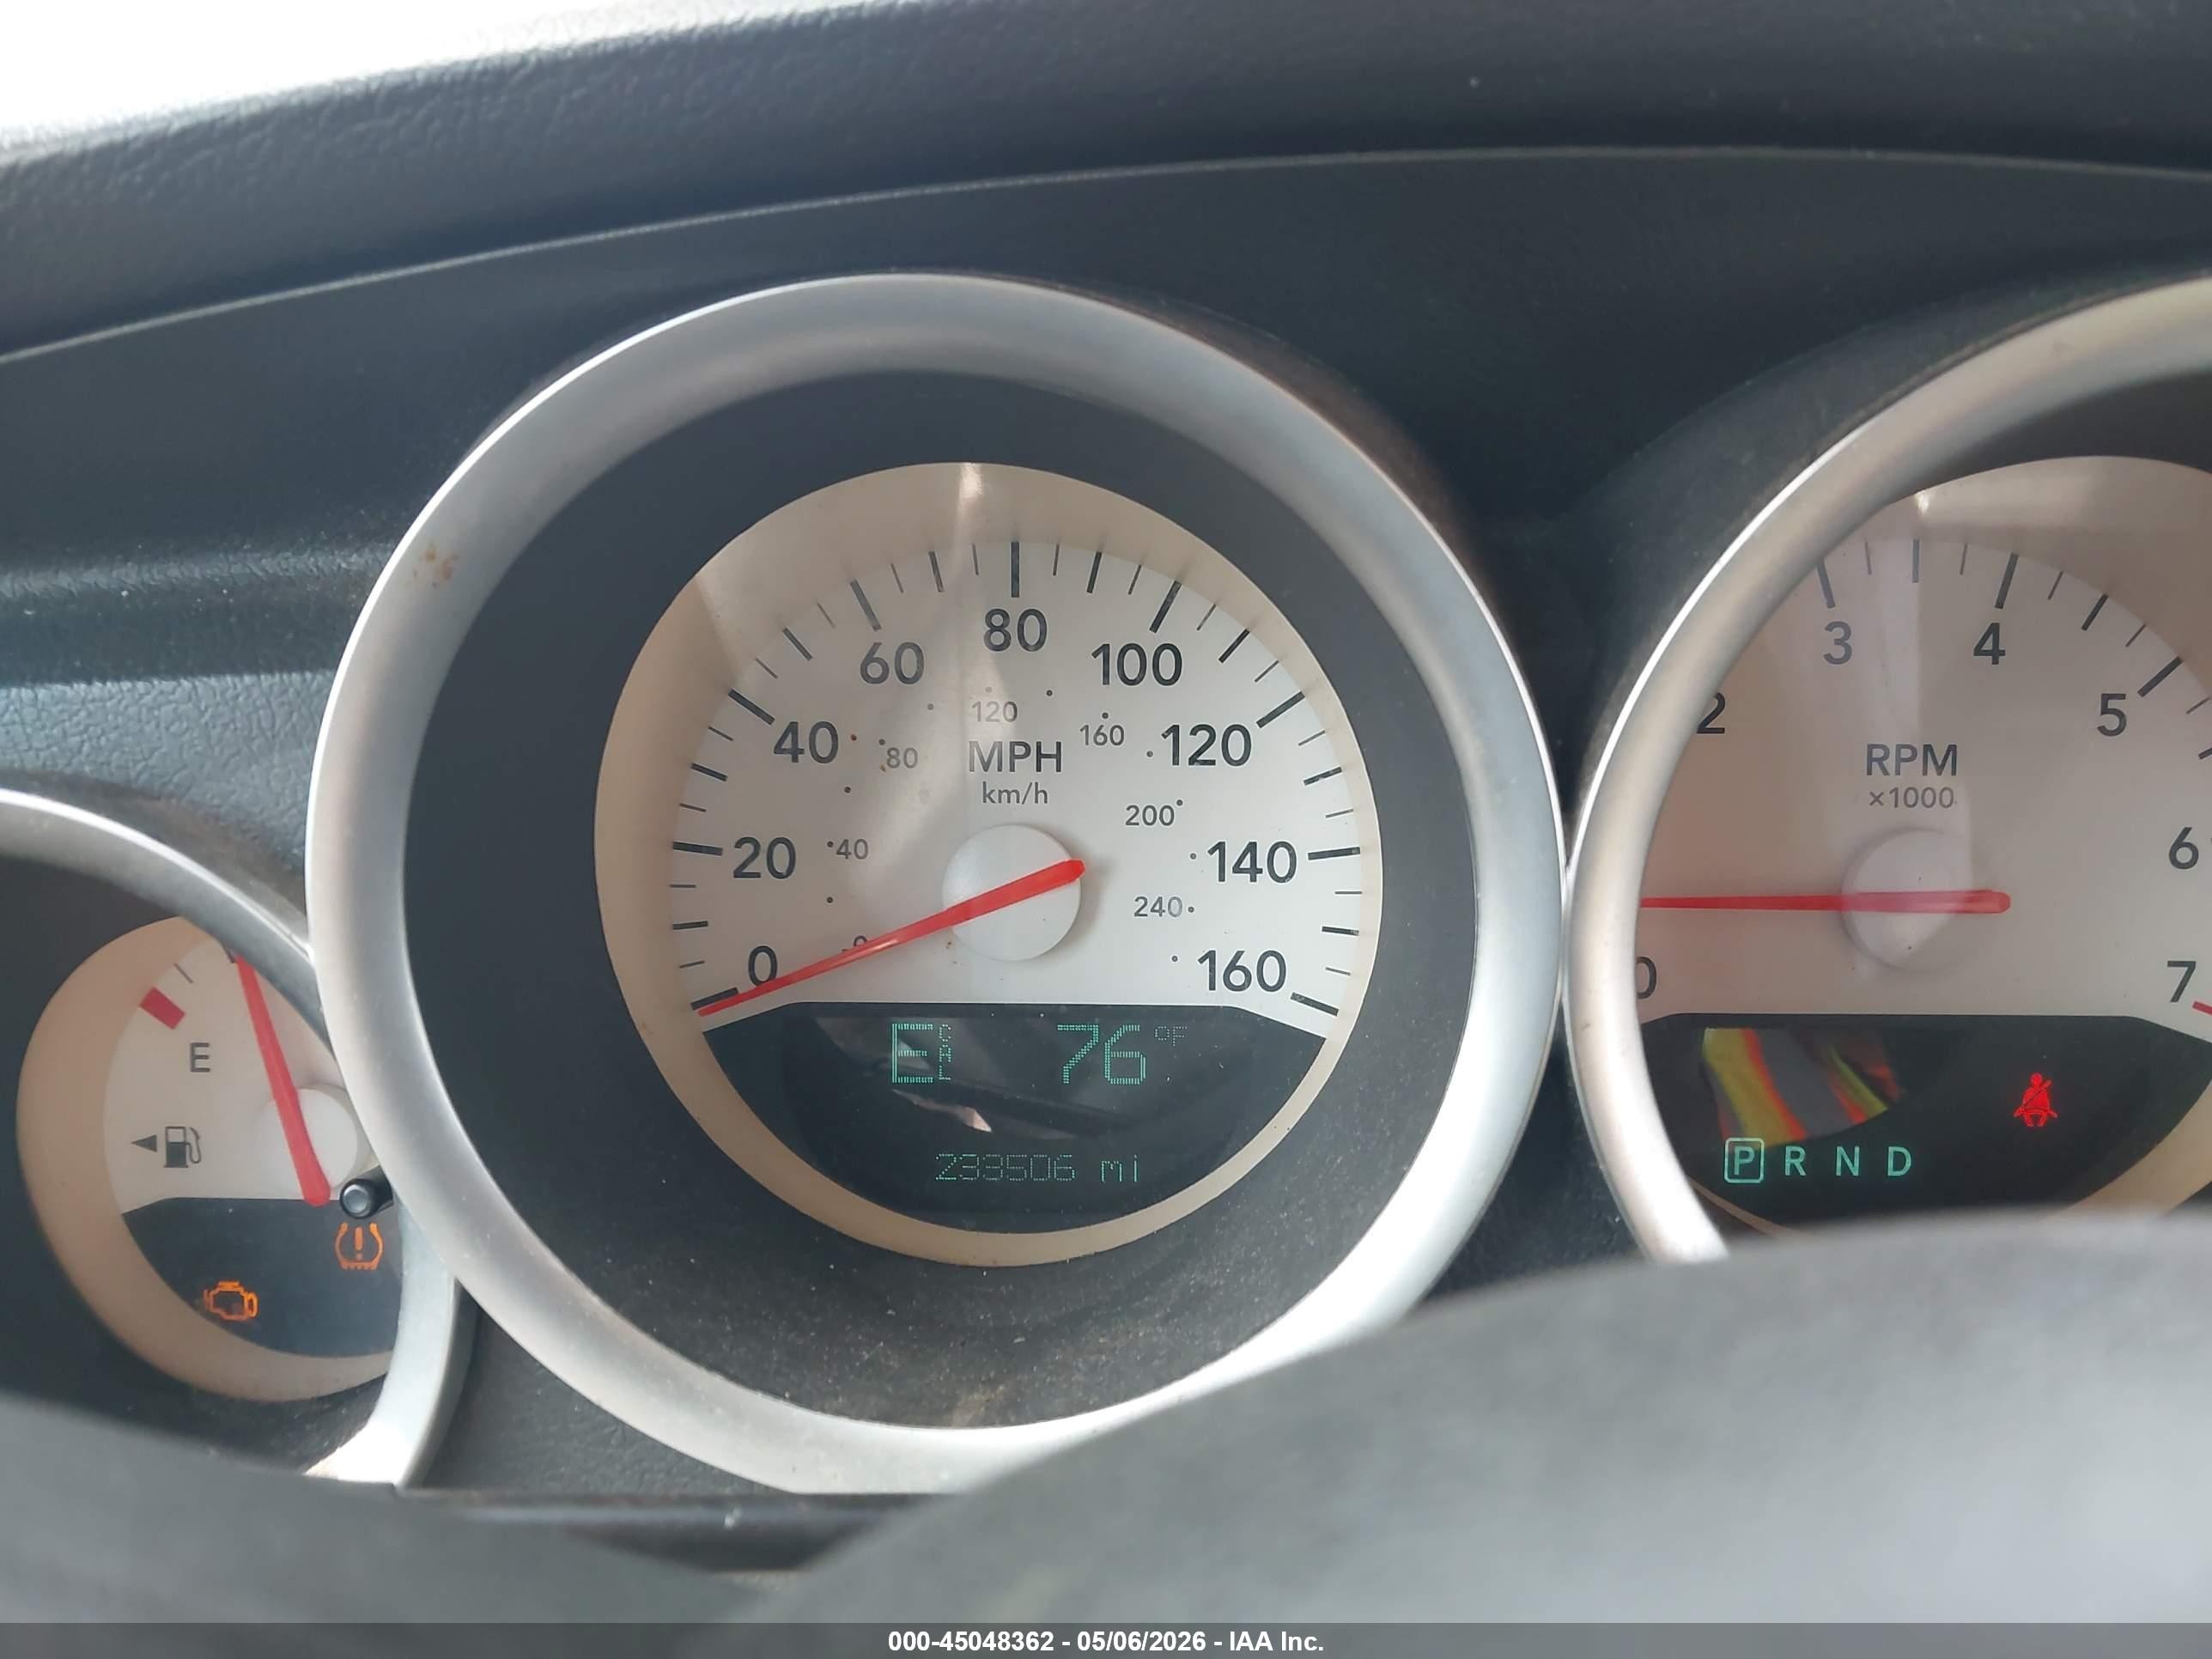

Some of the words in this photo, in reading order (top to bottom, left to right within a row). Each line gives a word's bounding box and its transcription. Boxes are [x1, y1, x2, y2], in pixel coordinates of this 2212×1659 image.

[983, 609, 1048, 651] 80
[1822, 621, 1853, 665] 3
[1972, 622, 2005, 665] 4
[860, 642, 925, 684] 60
[1091, 643, 1182, 685] 100
[971, 701, 1018, 722] 120
[1696, 692, 1727, 734] 2
[2096, 692, 2128, 736] 5
[774, 721, 839, 763] 40
[1079, 725, 1125, 746] 160
[1162, 724, 1252, 766] 120
[886, 747, 919, 769] 80
[969, 741, 1062, 773] MPH
[1865, 743, 1958, 776] RPM
[982, 781, 1048, 805] km/h
[1126, 805, 1175, 826] 200
[733, 837, 796, 879] 20
[836, 839, 868, 860] 40
[1207, 842, 1297, 883] 140
[2168, 827, 2199, 870] 6
[1134, 896, 1182, 917] 240
[748, 945, 778, 988] 0
[1198, 950, 1286, 992] 160
[1636, 956, 1657, 999] 0
[2167, 960, 2197, 1003] 7
[190, 1042, 210, 1073] E
[892, 1023, 933, 1083] E
[939, 1024, 951, 1080] CAL
[1057, 1024, 1146, 1085] 76
[935, 1153, 1075, 1182] 233506
[1101, 1154, 1138, 1182] mi
[1735, 1146, 1755, 1176] P
[1784, 1146, 1807, 1176] R
[1836, 1146, 1860, 1176] N
[1887, 1146, 1911, 1176] D
